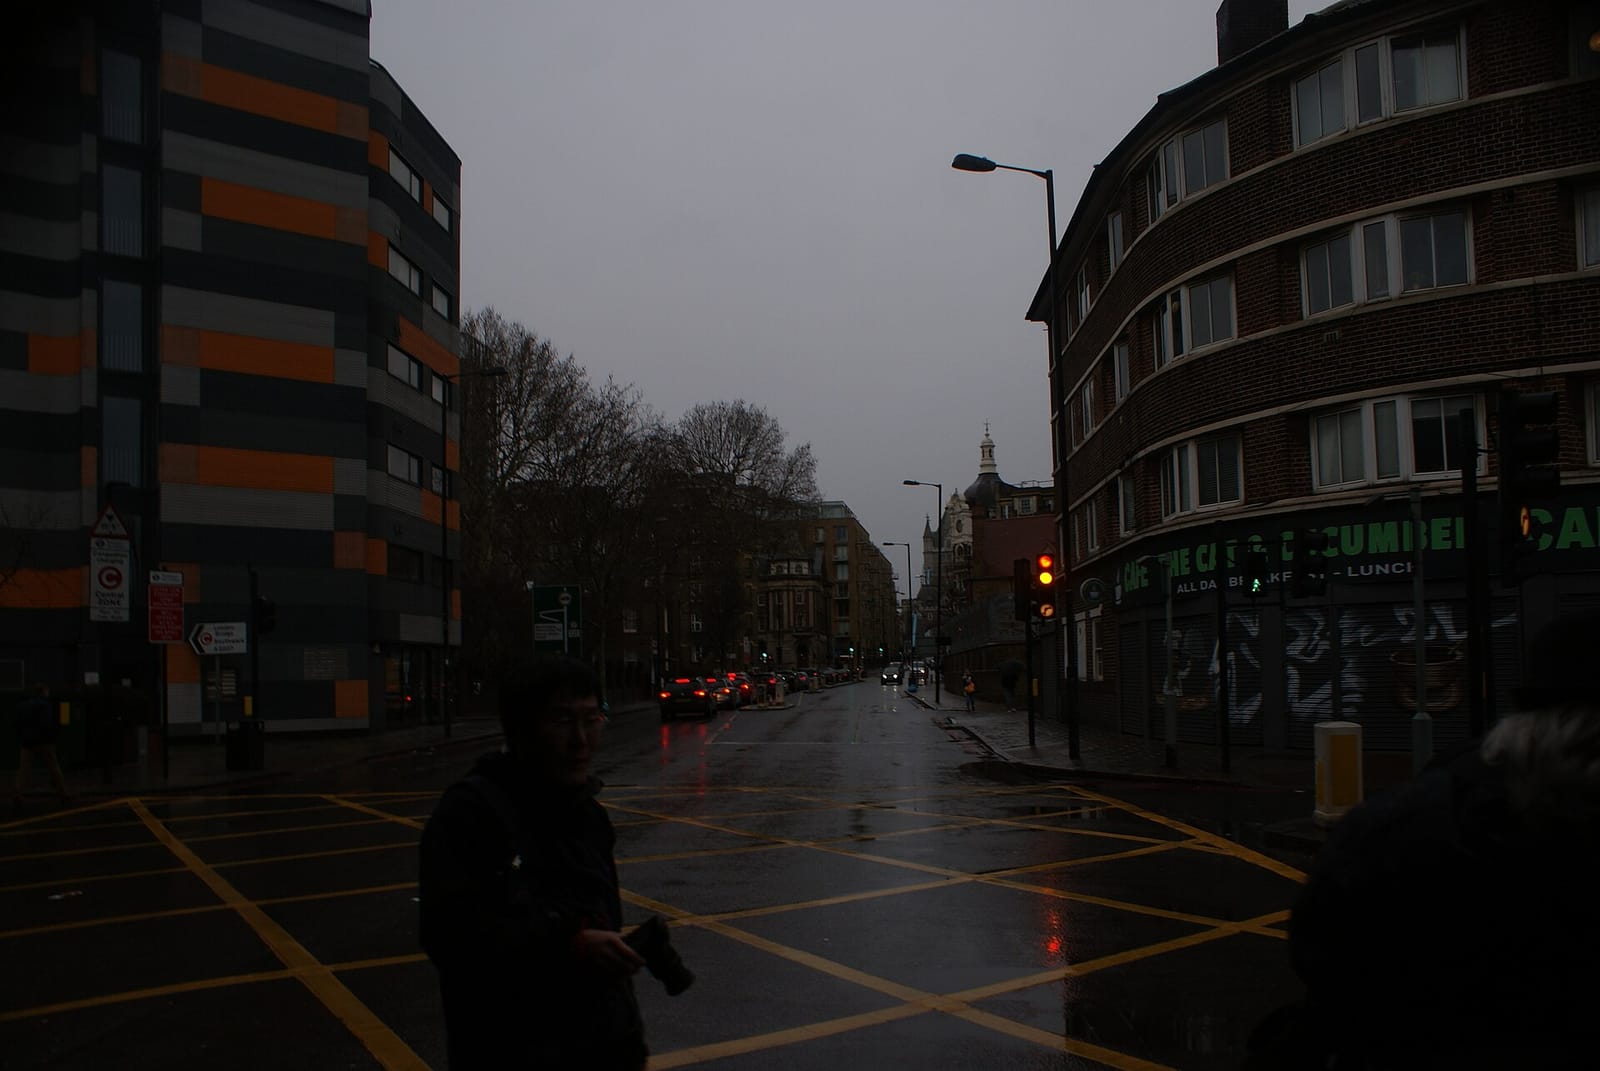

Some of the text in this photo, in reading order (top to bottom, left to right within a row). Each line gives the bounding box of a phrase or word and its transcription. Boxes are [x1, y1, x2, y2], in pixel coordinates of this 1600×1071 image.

[1279, 516, 1465, 561] CCUMBE
[1526, 505, 1600, 552] CA
[1176, 581, 1198, 595] ALL
[1199, 578, 1217, 591] DA
